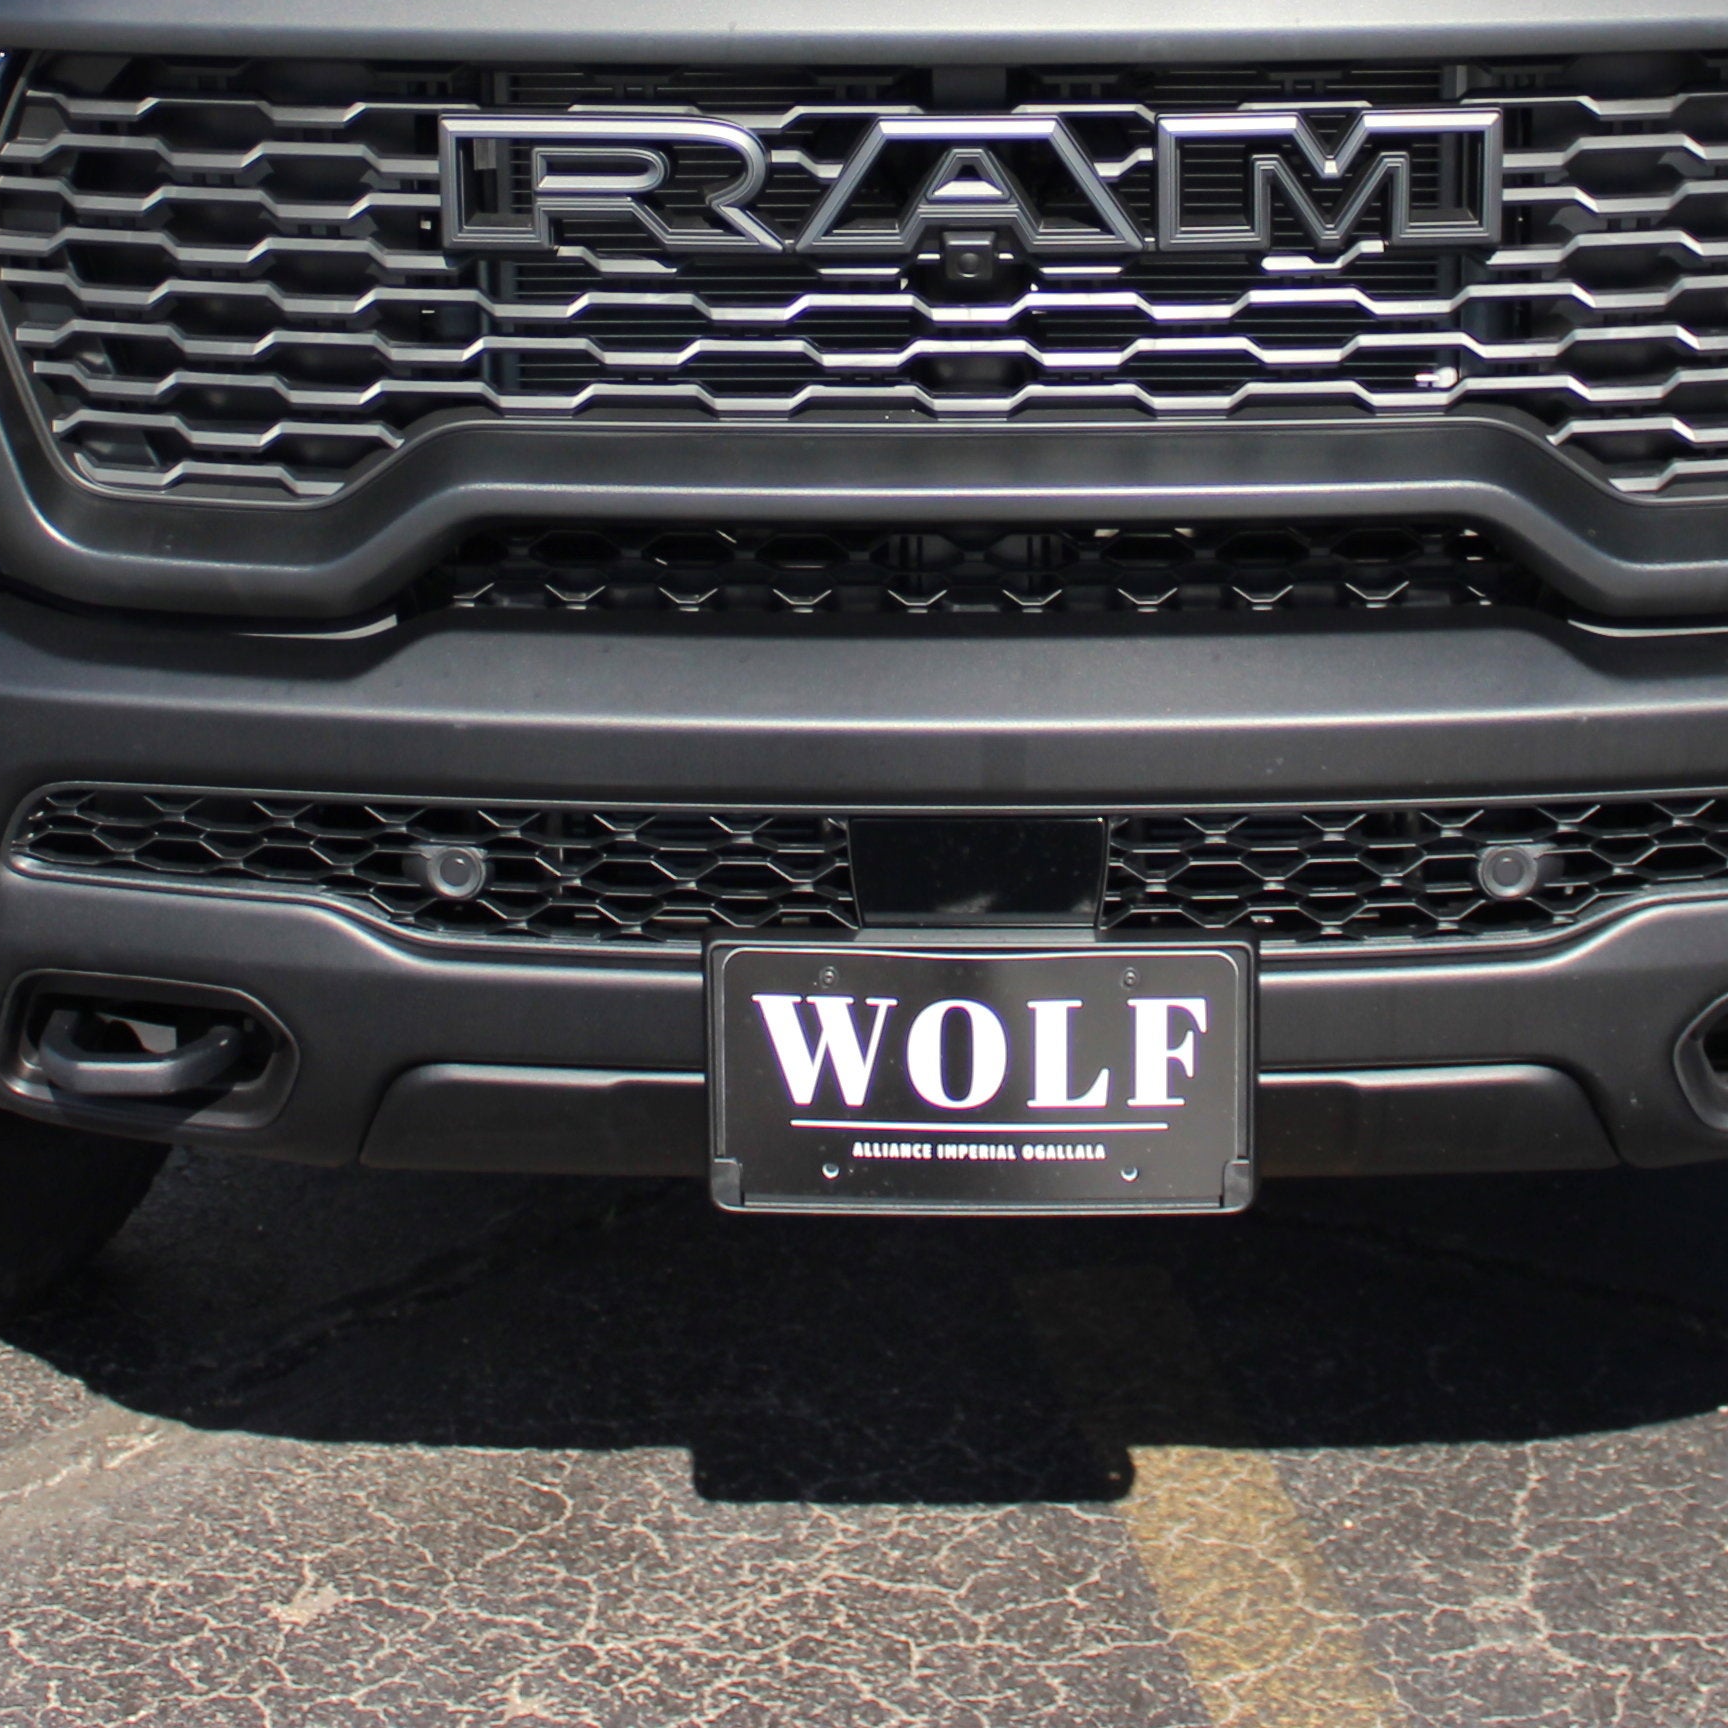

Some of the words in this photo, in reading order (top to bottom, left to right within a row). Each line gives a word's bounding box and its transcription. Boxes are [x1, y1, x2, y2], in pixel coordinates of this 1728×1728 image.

[438, 108, 1504, 253] RAM
[751, 992, 1208, 1109] WOLF
[851, 1141, 933, 1160] ALLIANCE
[936, 1142, 1017, 1161] IMPERIAL
[1021, 1143, 1107, 1161] OGALLALA
